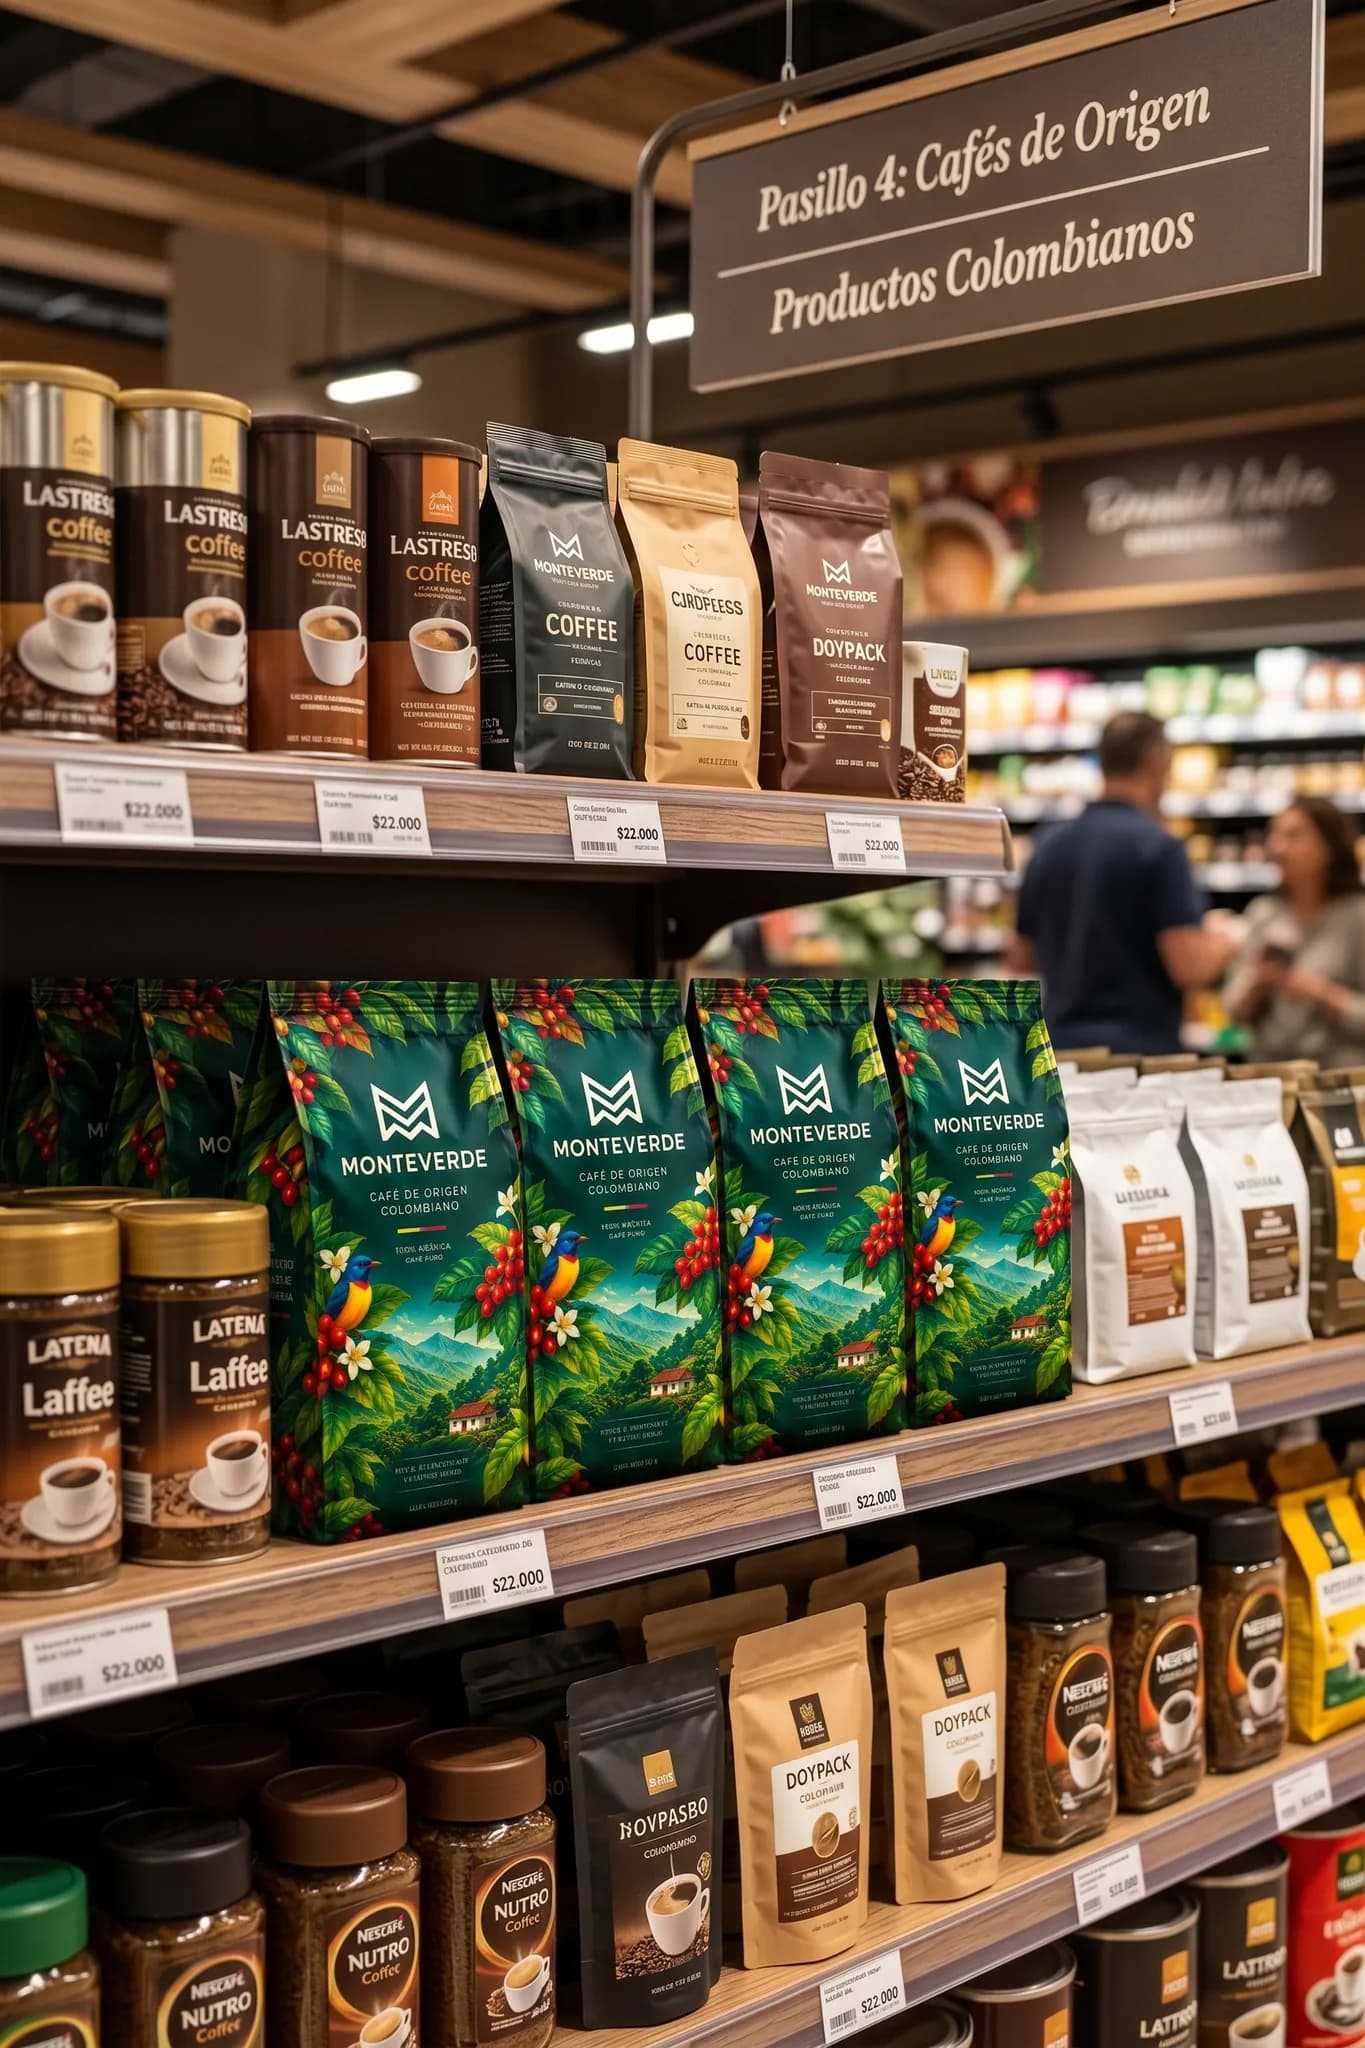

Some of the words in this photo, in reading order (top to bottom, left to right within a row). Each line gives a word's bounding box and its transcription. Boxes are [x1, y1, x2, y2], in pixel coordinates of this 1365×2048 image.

[758, 165, 866, 233] Pasillo
[873, 155, 908, 198] 4:
[914, 125, 1011, 196] Cafés
[1020, 112, 1065, 166] de
[1074, 85, 1211, 152] Origen
[769, 267, 938, 334] Productos
[945, 210, 1196, 296] Colombianos
[46, 516, 112, 546] coffee
[185, 533, 246, 561] coffee
[298, 547, 362, 573] coffee
[406, 561, 471, 585] coffee
[533, 558, 615, 583] MONTEVERDE
[805, 583, 878, 603] MONTEVERDE
[545, 612, 618, 642] COFFEE
[684, 642, 742, 666] COFFEE
[812, 637, 887, 663] DOYPACK
[123, 801, 184, 821] $22.000
[372, 814, 421, 831] $22.000
[617, 825, 659, 841] $22.000
[864, 839, 900, 853] $22.000
[750, 1122, 872, 1145] MONTEVERDE
[934, 1112, 1045, 1134] MONTEVERDE
[553, 1132, 686, 1158] MONTEVERDE
[981, 1143, 993, 1155] DE
[996, 1141, 1029, 1153] ORIGEN
[340, 1148, 488, 1176] MONTEVERDE
[802, 1154, 815, 1167] DE
[818, 1152, 856, 1166] ORIGEN
[964, 1154, 1022, 1167] COLOMBIANO
[610, 1168, 625, 1181] DE
[628, 1166, 668, 1180] ORIGEN
[782, 1166, 850, 1180] COLOMBIANO
[369, 1187, 400, 1203] CAFÉ
[404, 1187, 420, 1200] DE
[424, 1185, 468, 1200] ORIGEN
[588, 1181, 661, 1196] COLOMBIANO
[380, 1200, 460, 1217] COLOMBIANO
[192, 1313, 266, 1344] LATENA
[27, 1333, 112, 1365] LATENA
[189, 1354, 269, 1393] Laffee
[23, 1377, 115, 1418] Laffee
[856, 1488, 897, 1510] $22.000
[492, 1568, 544, 1594] $22.000
[101, 1653, 165, 1684] $22.000
[934, 1703, 991, 1736] DOYPACK
[786, 1752, 852, 1790] DOYPACK
[494, 1887, 549, 1922] NUTRO
[347, 1936, 410, 1973] NUTRO
[180, 1991, 252, 2030] NUTRO
